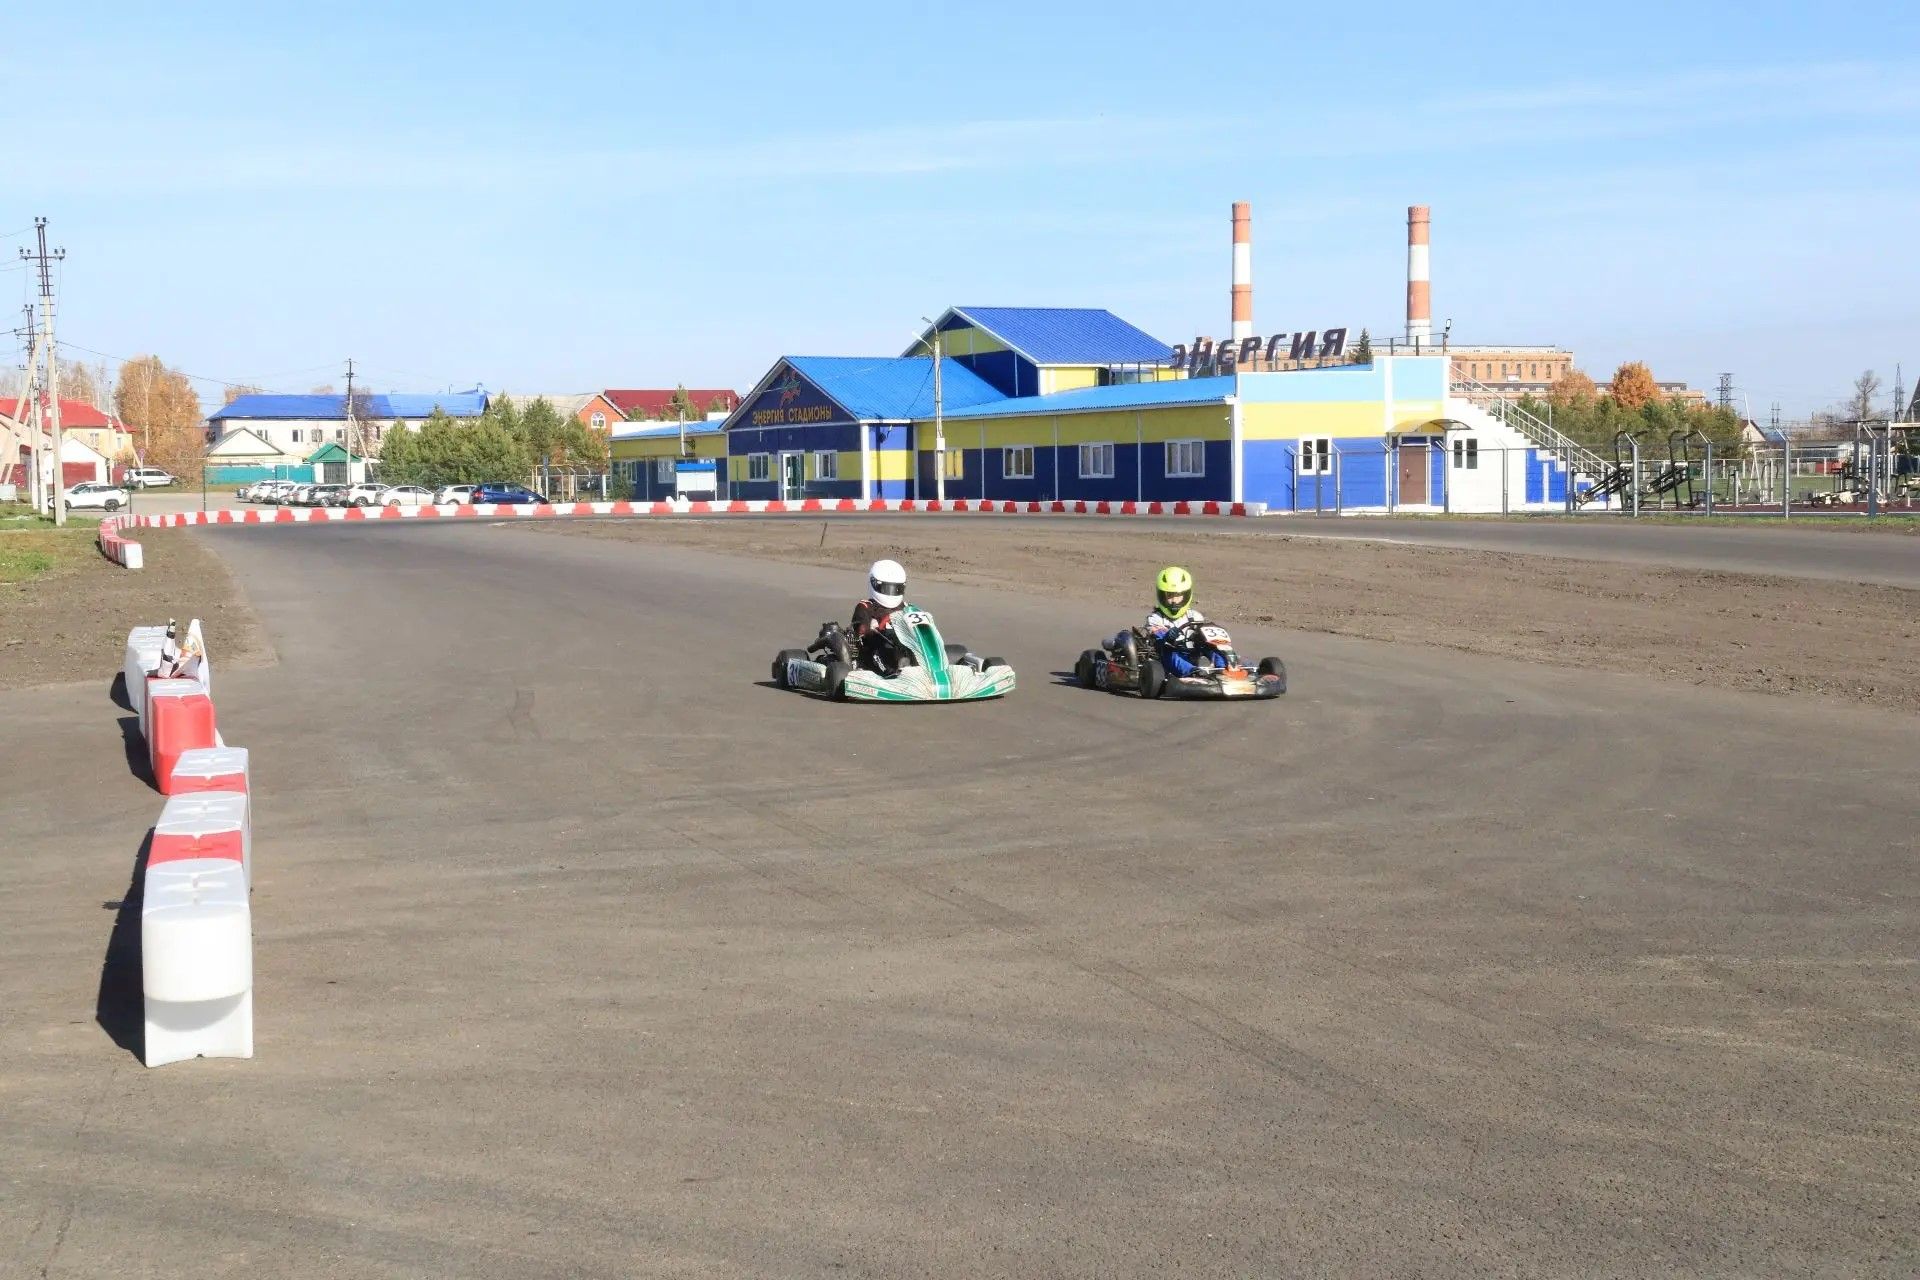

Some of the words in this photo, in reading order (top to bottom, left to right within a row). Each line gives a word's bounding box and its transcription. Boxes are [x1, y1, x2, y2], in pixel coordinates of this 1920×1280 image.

[1169, 327, 1348, 370] ЭНЕРГИЯ
[752, 410, 784, 424] ЭНЕРГИЯ
[788, 406, 832, 423] СТАДИОНЫ
